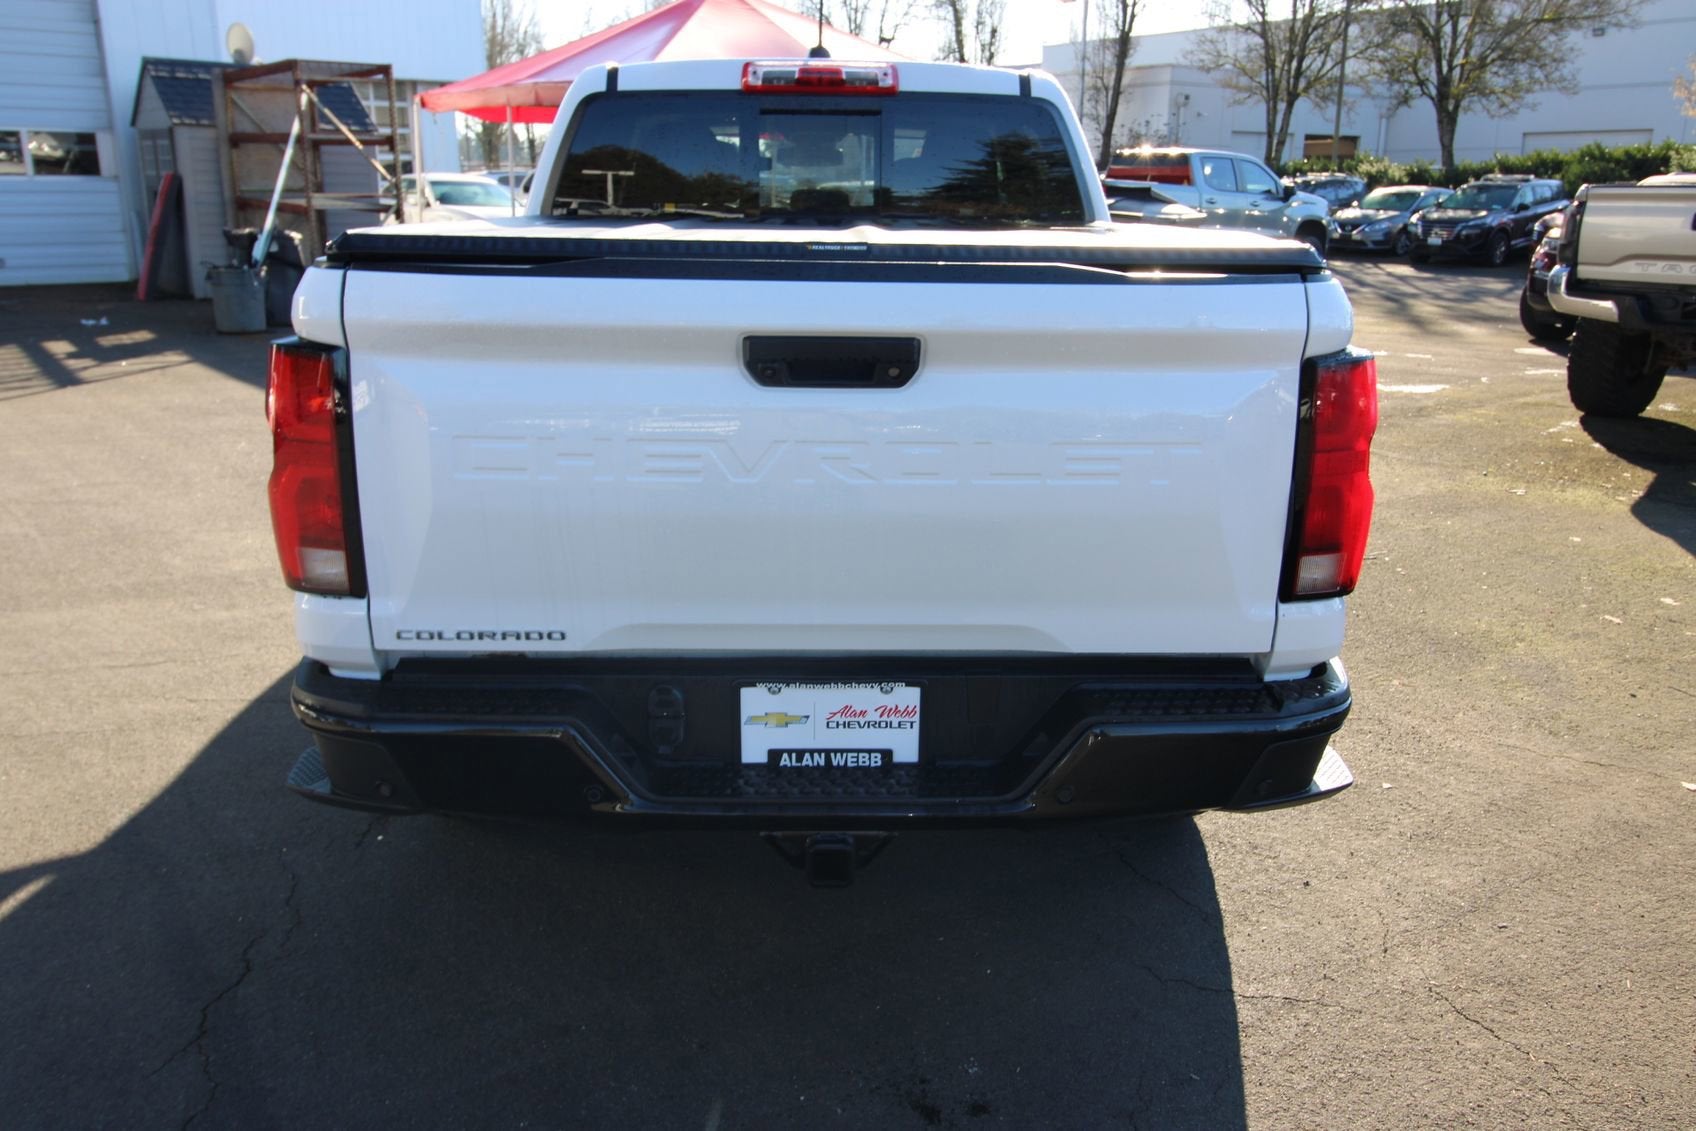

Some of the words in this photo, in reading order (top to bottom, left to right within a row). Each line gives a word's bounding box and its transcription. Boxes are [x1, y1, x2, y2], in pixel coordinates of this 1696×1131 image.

[452, 436, 1202, 485] CHEVROLET
[396, 629, 567, 642] COLORADO
[756, 681, 906, 690] www.alanwebbchevy.com
[826, 704, 868, 720] Alan
[874, 704, 917, 719] Webb
[826, 720, 917, 730] CHEVROLET
[779, 752, 825, 768] ALAN
[830, 752, 882, 768] WEBB
